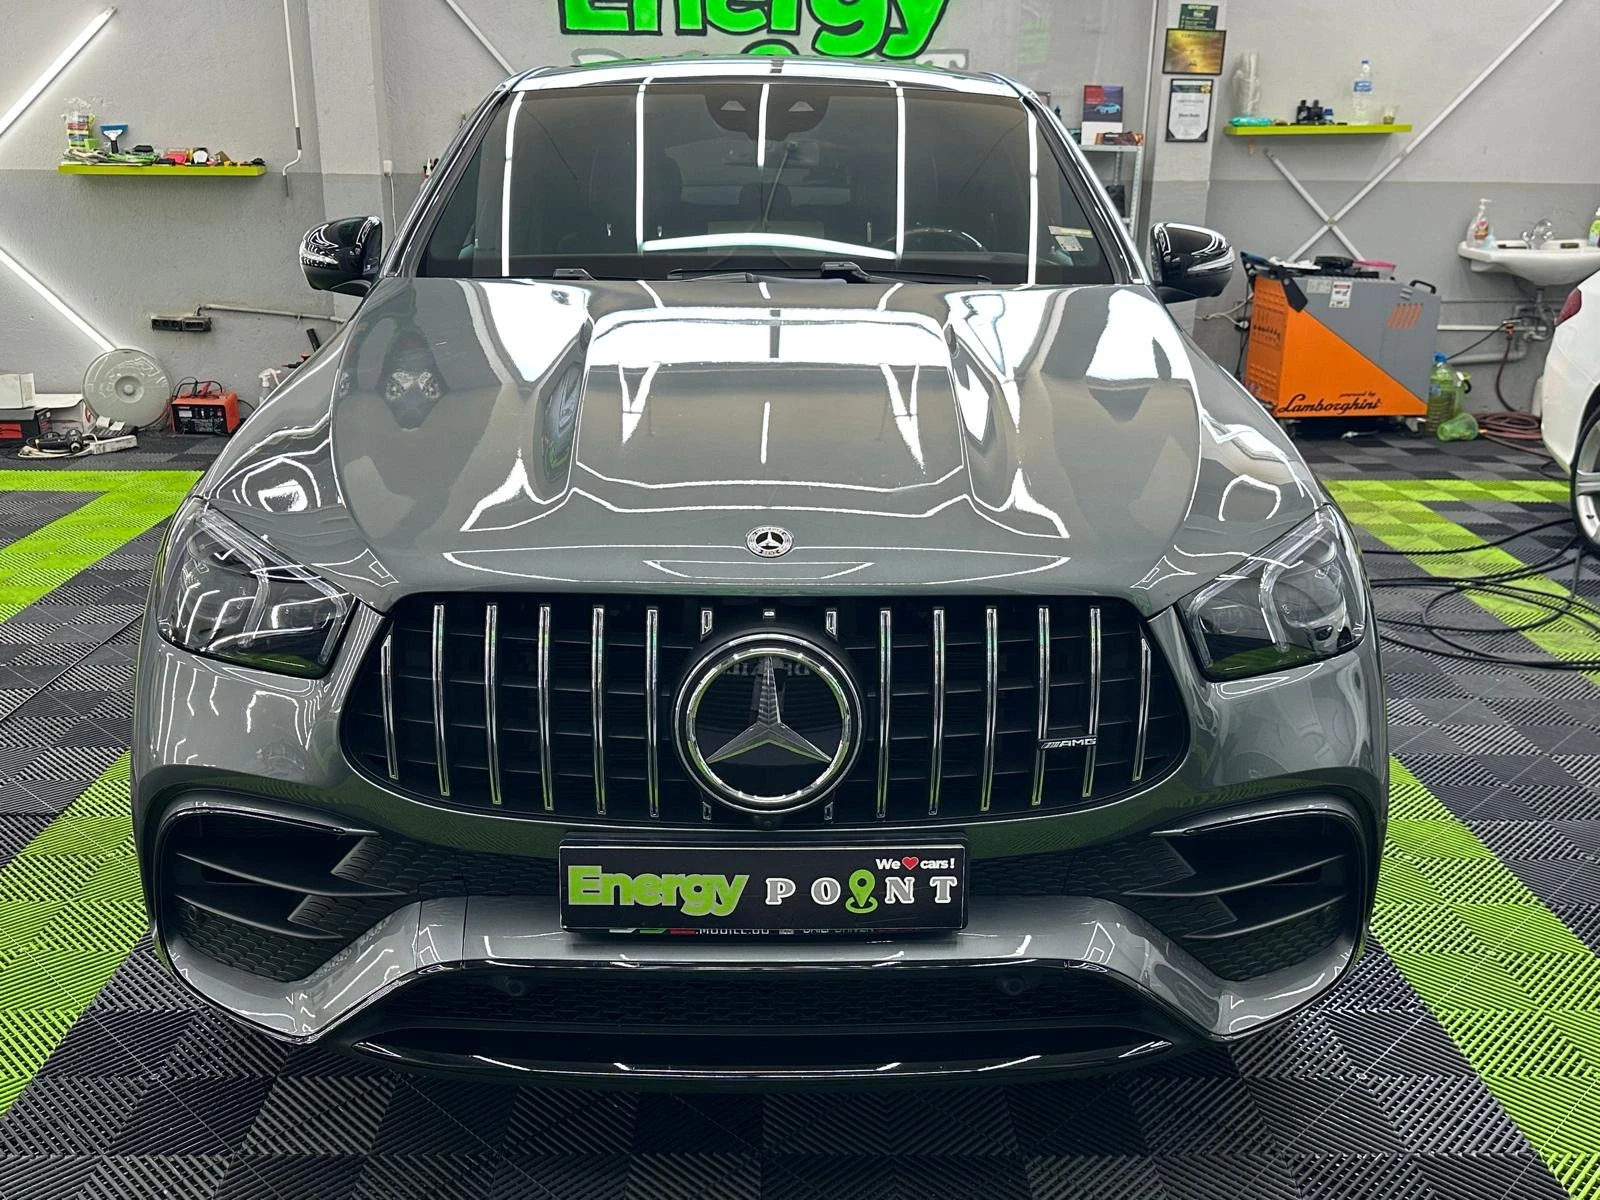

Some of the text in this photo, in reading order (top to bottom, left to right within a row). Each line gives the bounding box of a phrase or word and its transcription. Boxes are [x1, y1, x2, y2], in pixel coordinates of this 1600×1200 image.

[1276, 393, 1382, 415] Lamborghini
[1058, 738, 1097, 748] AMG
[875, 858, 901, 870] We
[567, 865, 750, 916] Energy
